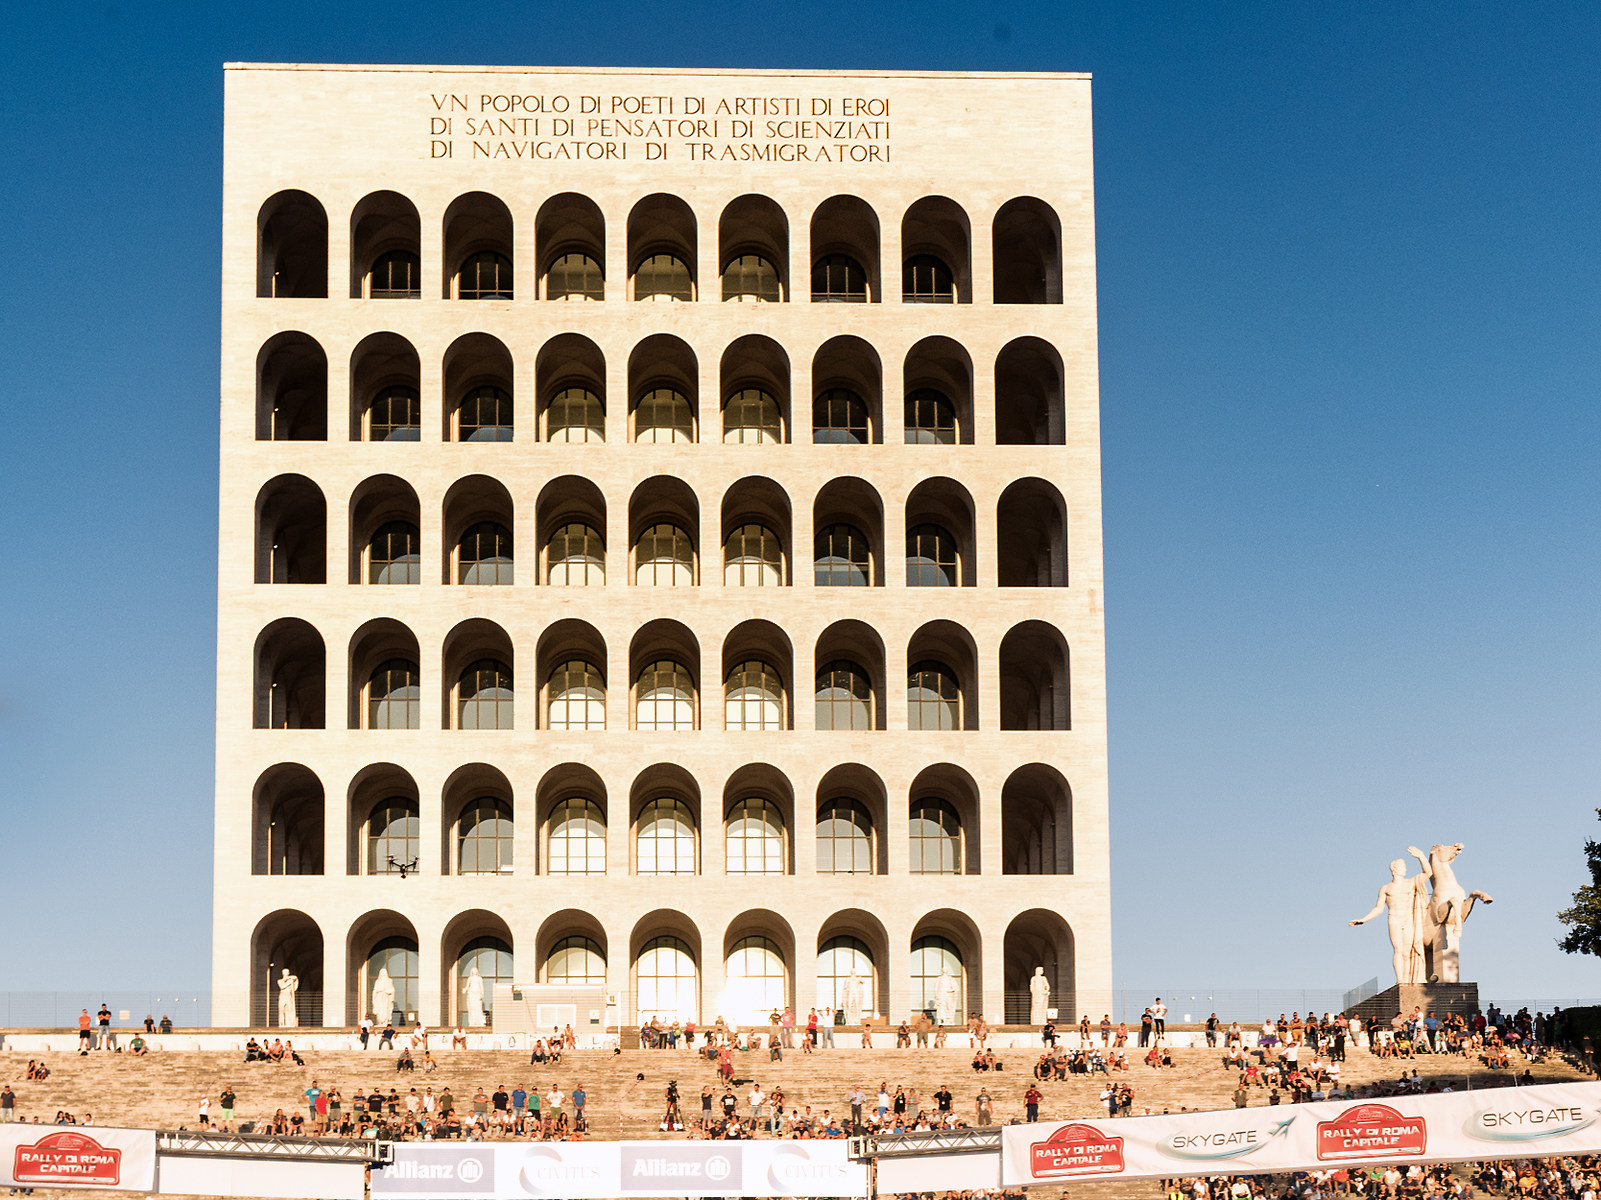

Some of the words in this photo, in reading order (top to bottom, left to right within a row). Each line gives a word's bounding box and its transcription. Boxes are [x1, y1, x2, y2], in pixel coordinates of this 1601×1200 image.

[431, 93, 468, 112] VN
[480, 94, 570, 113] POPOLO
[579, 95, 601, 113] DI
[611, 96, 673, 114] POETI
[684, 96, 705, 115] DI
[715, 97, 800, 115] ARTISTI
[811, 98, 831, 116] DI
[843, 98, 889, 117] EROI
[430, 117, 452, 135] DI
[465, 117, 539, 136] SANTI
[552, 118, 574, 137] DI
[587, 118, 718, 138] PENSATORI
[731, 119, 753, 138] DI
[765, 120, 890, 139] SCIENZIATI
[430, 140, 452, 158] DI
[472, 140, 626, 160] NAVIGATORI
[645, 141, 667, 160] DI
[685, 142, 890, 162] TRASMIGRATORI
[1482, 1106, 1583, 1128] SKYGATE
[1172, 1130, 1257, 1149] SKYGATE
[1323, 1127, 1362, 1139] RALLY
[1365, 1126, 1381, 1136] DI
[1384, 1124, 1421, 1136] ROMA
[1035, 1147, 1070, 1158] RALLY
[1073, 1146, 1084, 1156] DI
[1087, 1144, 1118, 1154] ROMA
[1343, 1136, 1399, 1148] CAPITALE
[21, 1153, 62, 1163] RALLY
[65, 1154, 77, 1163] DI
[81, 1155, 116, 1164] ROMA
[632, 1158, 702, 1177] Allianz
[1053, 1155, 1102, 1167] CAPITALE
[39, 1164, 96, 1174] CAPITALE
[384, 1160, 453, 1179] Allianz
